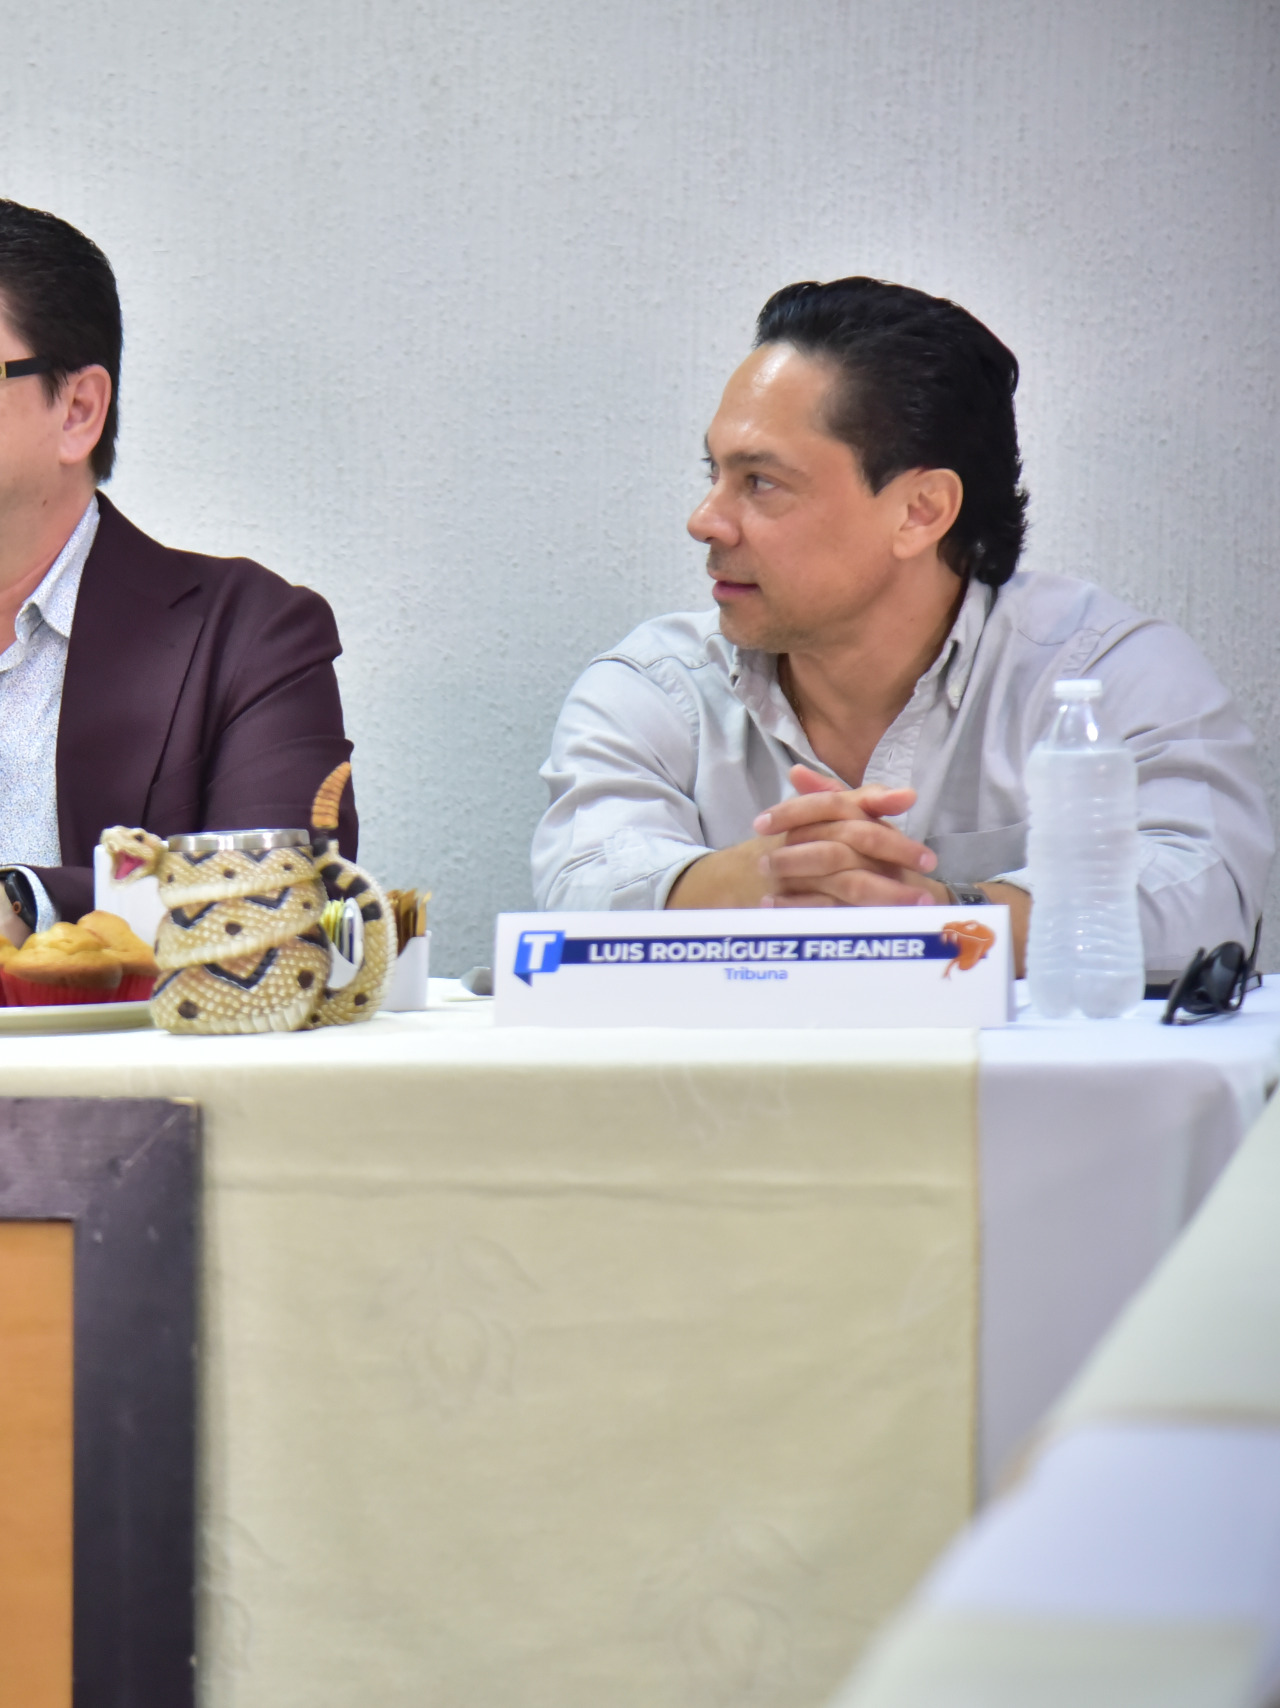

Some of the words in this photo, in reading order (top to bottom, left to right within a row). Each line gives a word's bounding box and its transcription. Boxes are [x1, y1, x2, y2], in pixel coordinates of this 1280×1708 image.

[590, 942, 645, 962] LUIS
[650, 937, 799, 961] RODRÍGUEZ
[804, 939, 926, 959] FREANER
[724, 967, 788, 980] Tribuna
